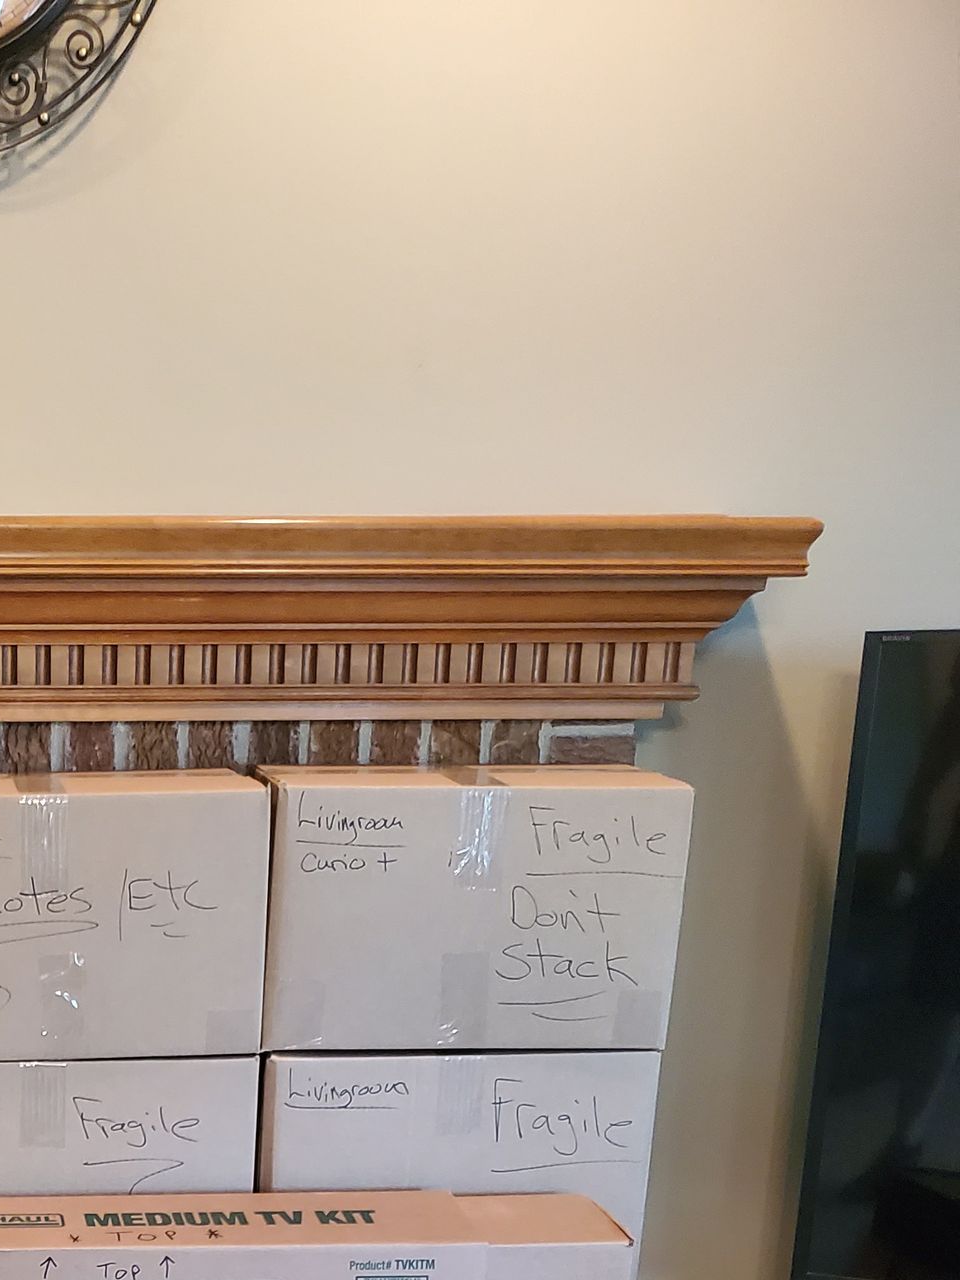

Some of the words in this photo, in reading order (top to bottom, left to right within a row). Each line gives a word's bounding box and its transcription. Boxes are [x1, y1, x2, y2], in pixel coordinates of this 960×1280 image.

[528, 805, 668, 864] Fragile
[510, 885, 622, 933] Don't
[494, 938, 640, 986] Stack
[71, 1096, 201, 1148] Fragile
[491, 1077, 634, 1156] Fragile
[83, 1210, 250, 1228] MEDIUM
[253, 1209, 304, 1226] TV
[313, 1208, 377, 1225] KIT
[105, 1230, 177, 1243] TOP
[394, 1258, 436, 1270] TVKITM
